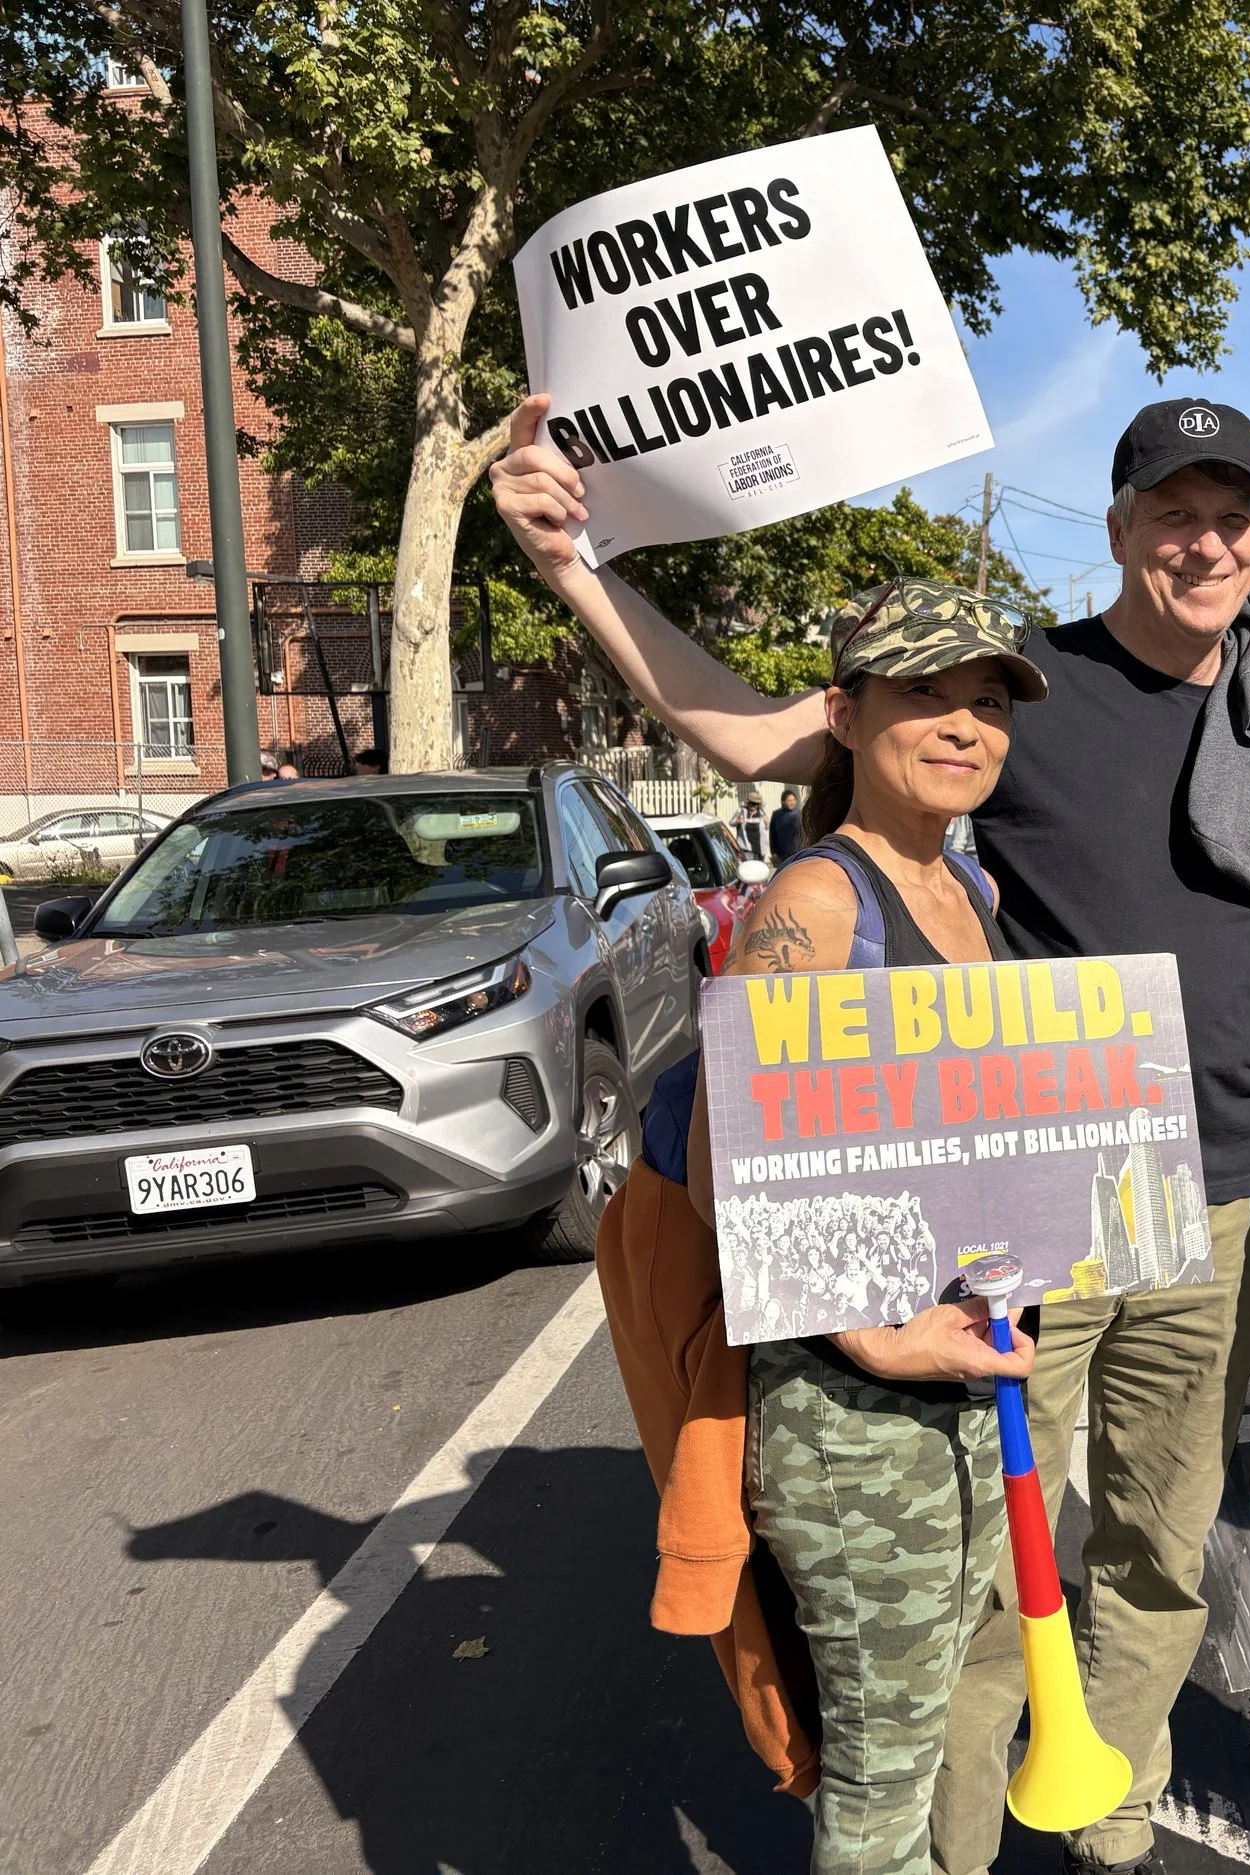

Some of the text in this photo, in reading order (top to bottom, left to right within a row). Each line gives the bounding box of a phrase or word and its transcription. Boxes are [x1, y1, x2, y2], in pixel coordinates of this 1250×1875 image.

[549, 177, 811, 310] WORKERS
[625, 272, 783, 368] OVER
[547, 309, 921, 470] BILLIONAIRES!
[1182, 413, 1217, 432] DIA
[729, 454, 782, 478] FEDERATION OF
[730, 445, 774, 466] CALIFORNIA
[728, 463, 794, 493] LABOR UNIONS
[746, 960, 1153, 1065] WE BUILD.
[750, 1043, 1164, 1141] THEY BREAK.
[152, 1155, 227, 1173] California
[731, 1114, 1188, 1185] WORKING FAMILIES, NOT BILLIONAIRES!
[138, 1167, 245, 1205] 9YAR306
[163, 1196, 226, 1208] dmv.ca.gov
[957, 1241, 1009, 1255] LOCAL 1021
